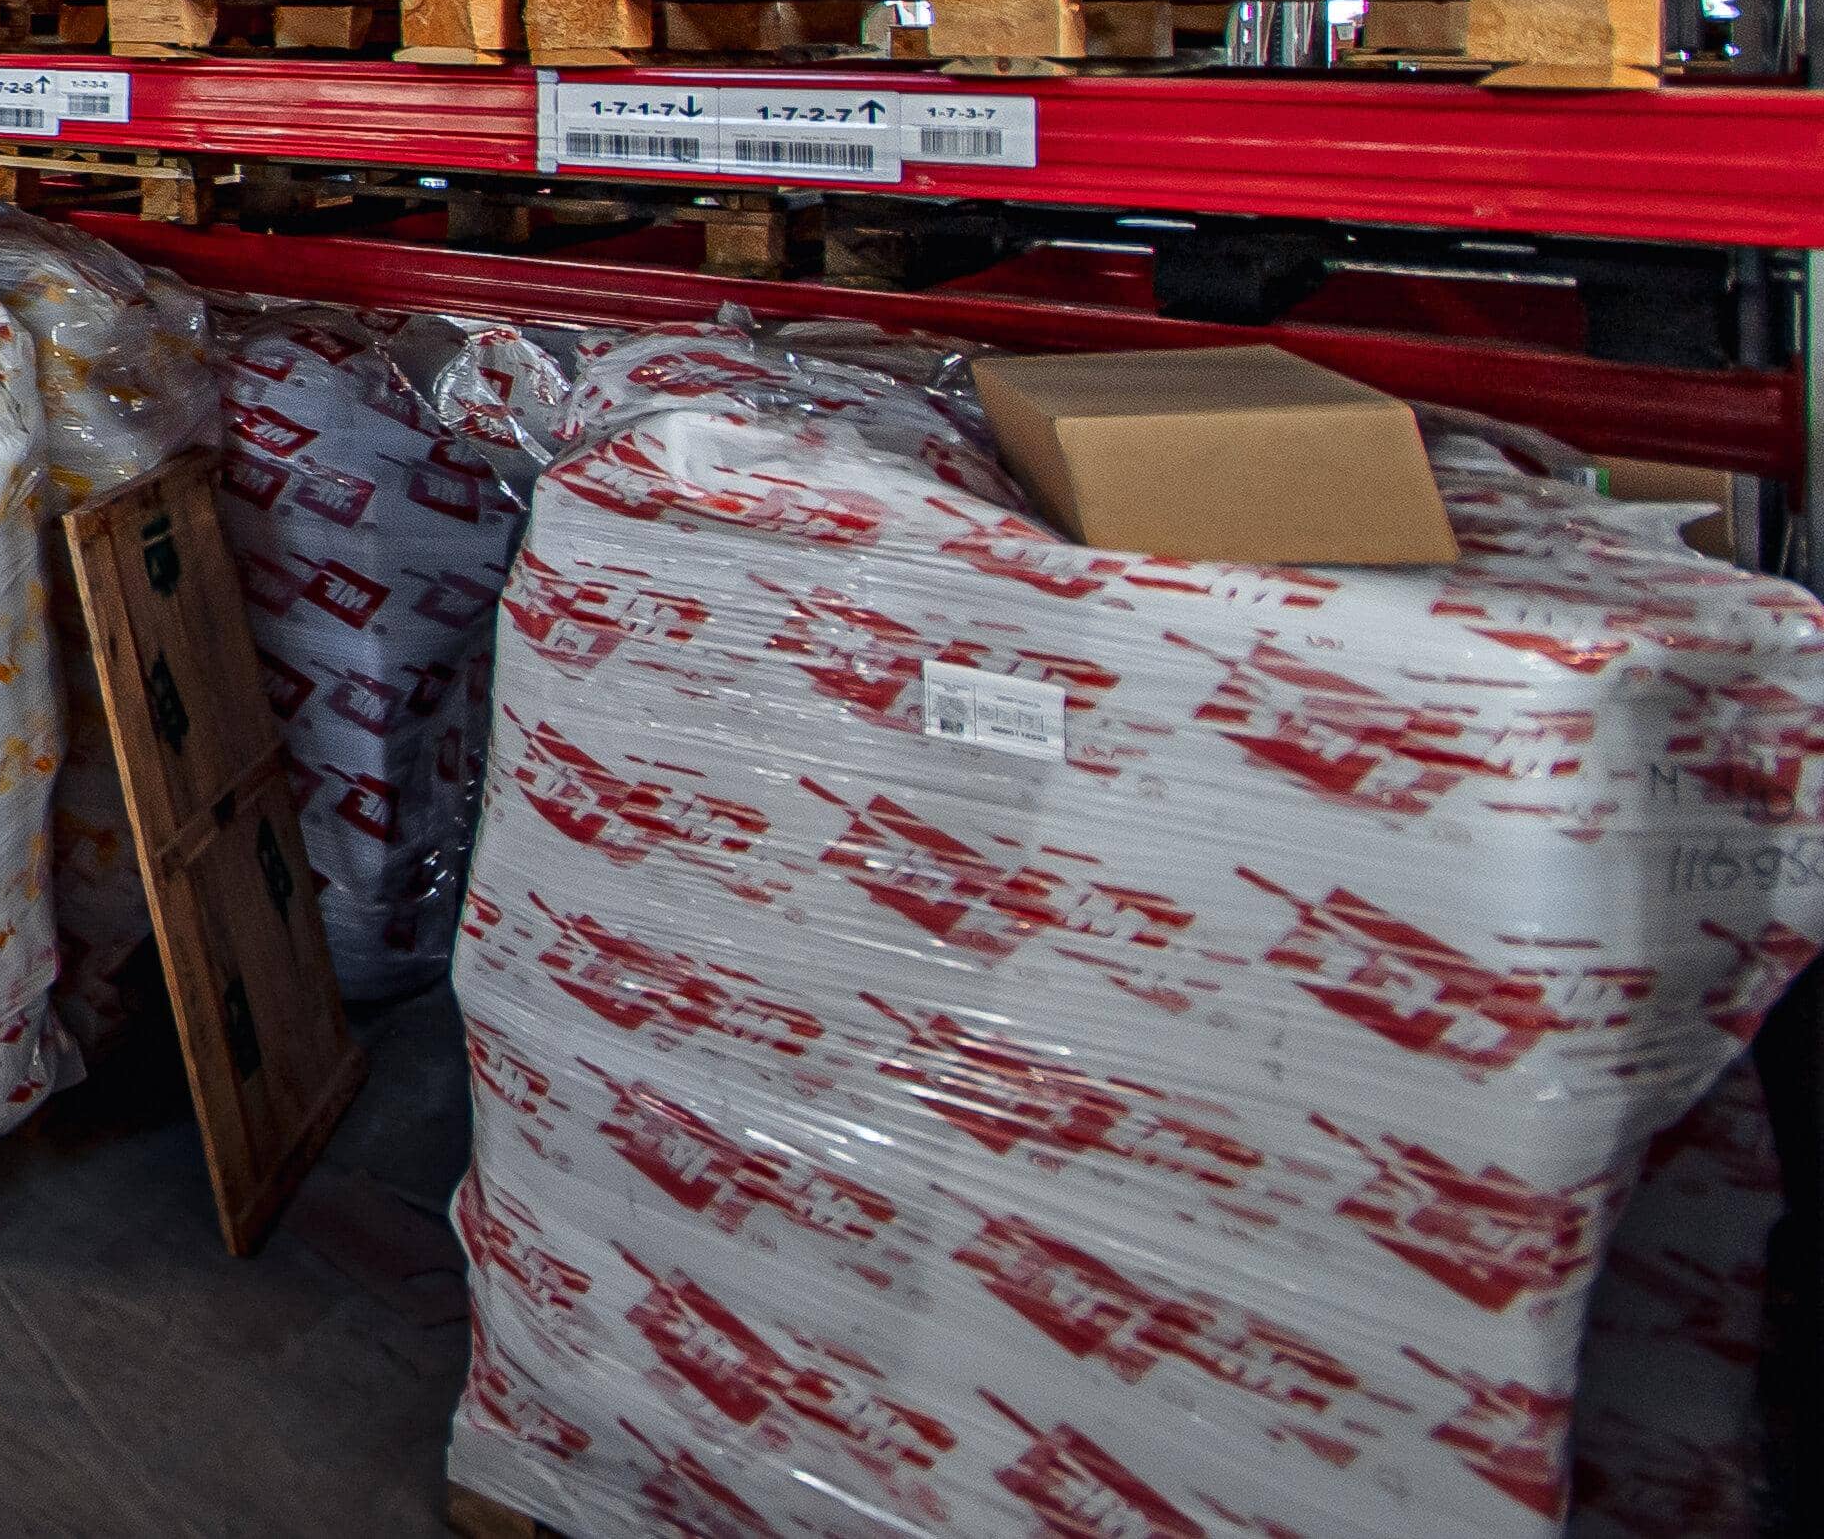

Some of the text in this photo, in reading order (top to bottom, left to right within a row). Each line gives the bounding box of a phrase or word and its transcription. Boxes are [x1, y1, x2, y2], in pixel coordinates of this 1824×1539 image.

[590, 100, 996, 124] 1-7-1-7 1-7-2-7 1-7-3-7
